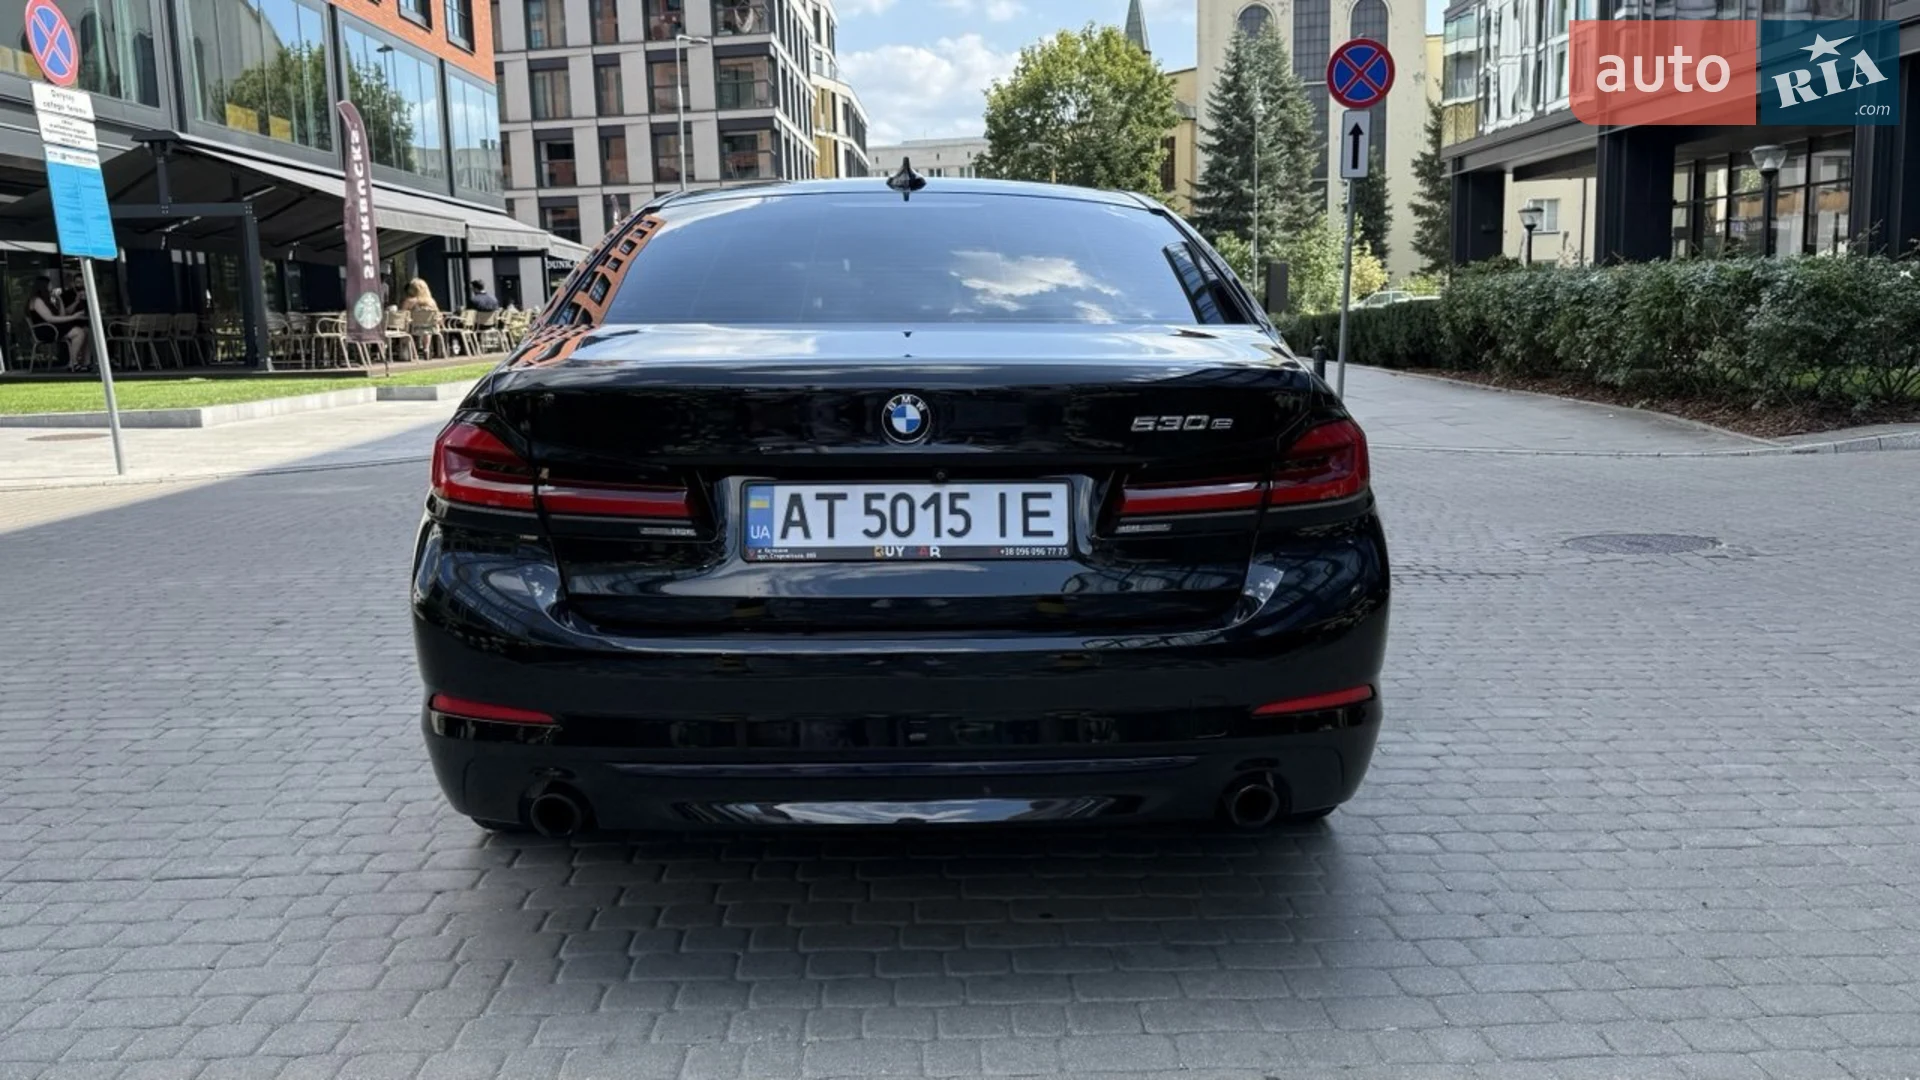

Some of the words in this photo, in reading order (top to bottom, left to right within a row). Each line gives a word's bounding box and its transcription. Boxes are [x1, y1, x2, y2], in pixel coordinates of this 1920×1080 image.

[779, 492, 848, 540] AT
[862, 492, 972, 538] 5015
[999, 491, 1054, 537] IE
[750, 527, 771, 540] UA
